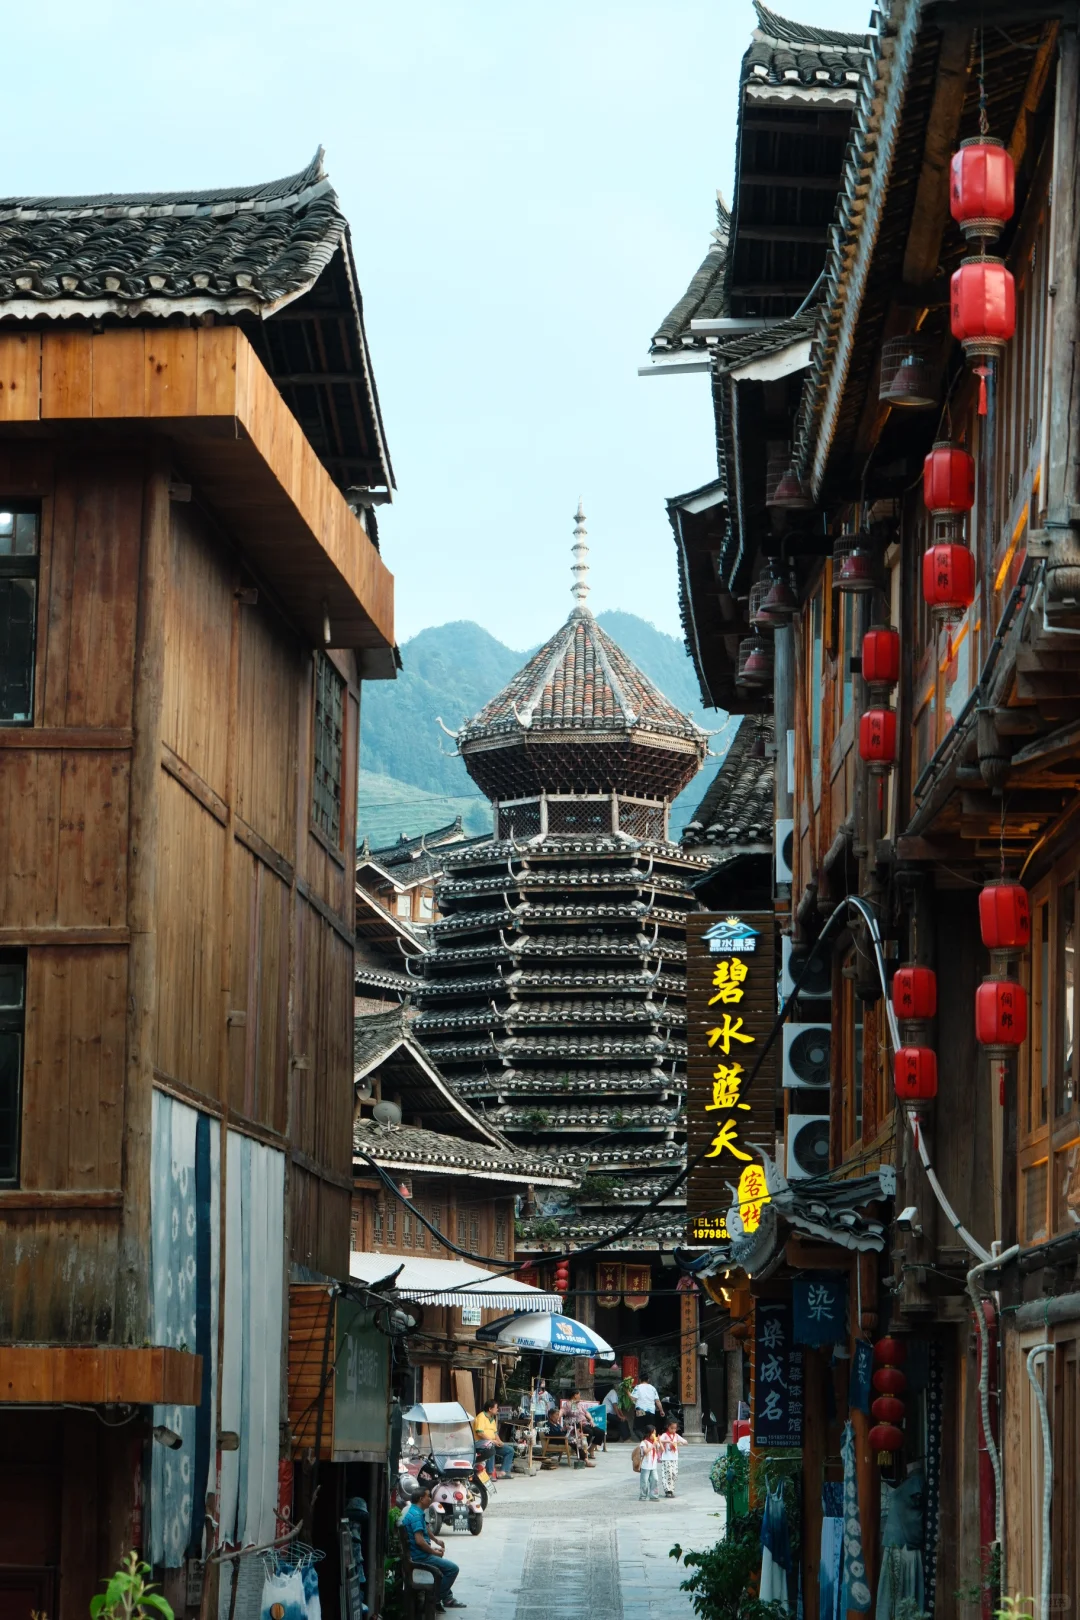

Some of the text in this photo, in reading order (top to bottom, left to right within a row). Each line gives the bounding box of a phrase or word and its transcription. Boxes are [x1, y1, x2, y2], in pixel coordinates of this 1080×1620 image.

[709, 938, 756, 947] 碧水蓝天
[704, 957, 756, 1161] 碧水蓝天
[742, 1170, 763, 1228] 客栈
[807, 1284, 835, 1322] 染
[758, 1303, 788, 1421] 一染成名
[788, 1351, 803, 1432] 蜡染体验馆
